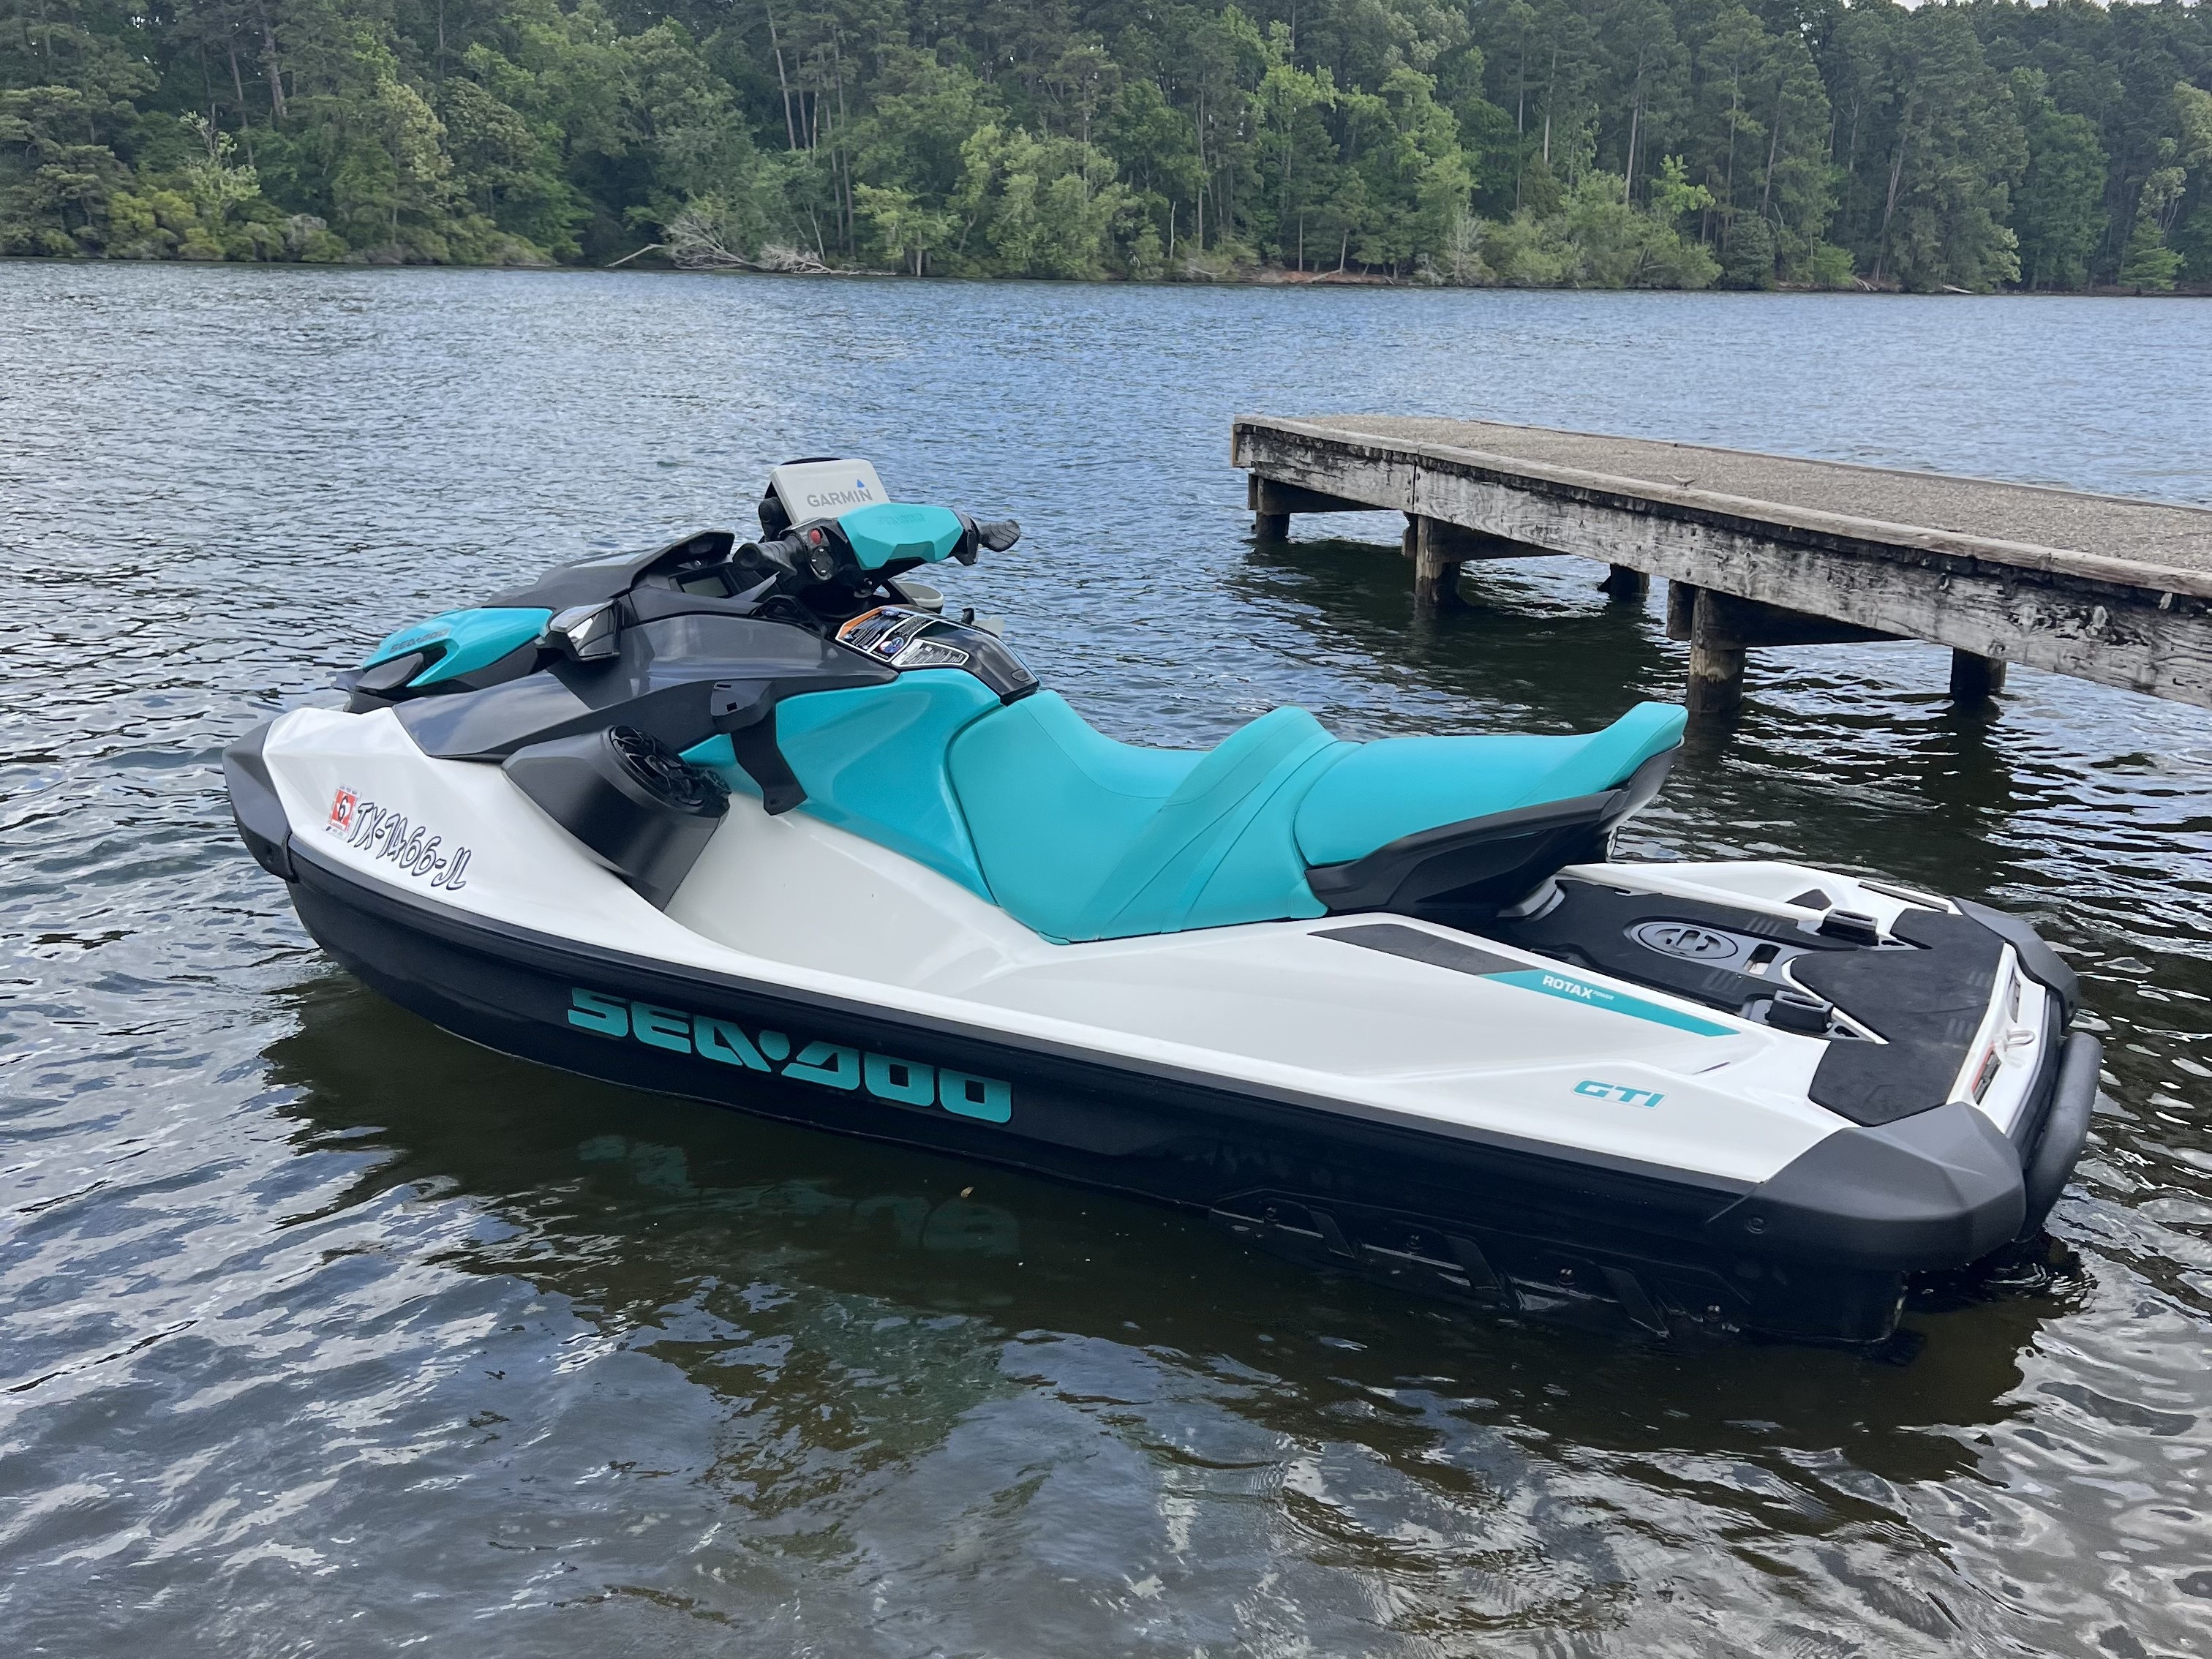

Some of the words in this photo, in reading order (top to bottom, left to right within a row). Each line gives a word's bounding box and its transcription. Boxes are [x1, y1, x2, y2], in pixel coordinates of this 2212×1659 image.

[807, 488, 873, 508] GARMIN
[1542, 974, 1594, 1000] ROTAX
[1573, 1080, 1666, 1109] GTI
